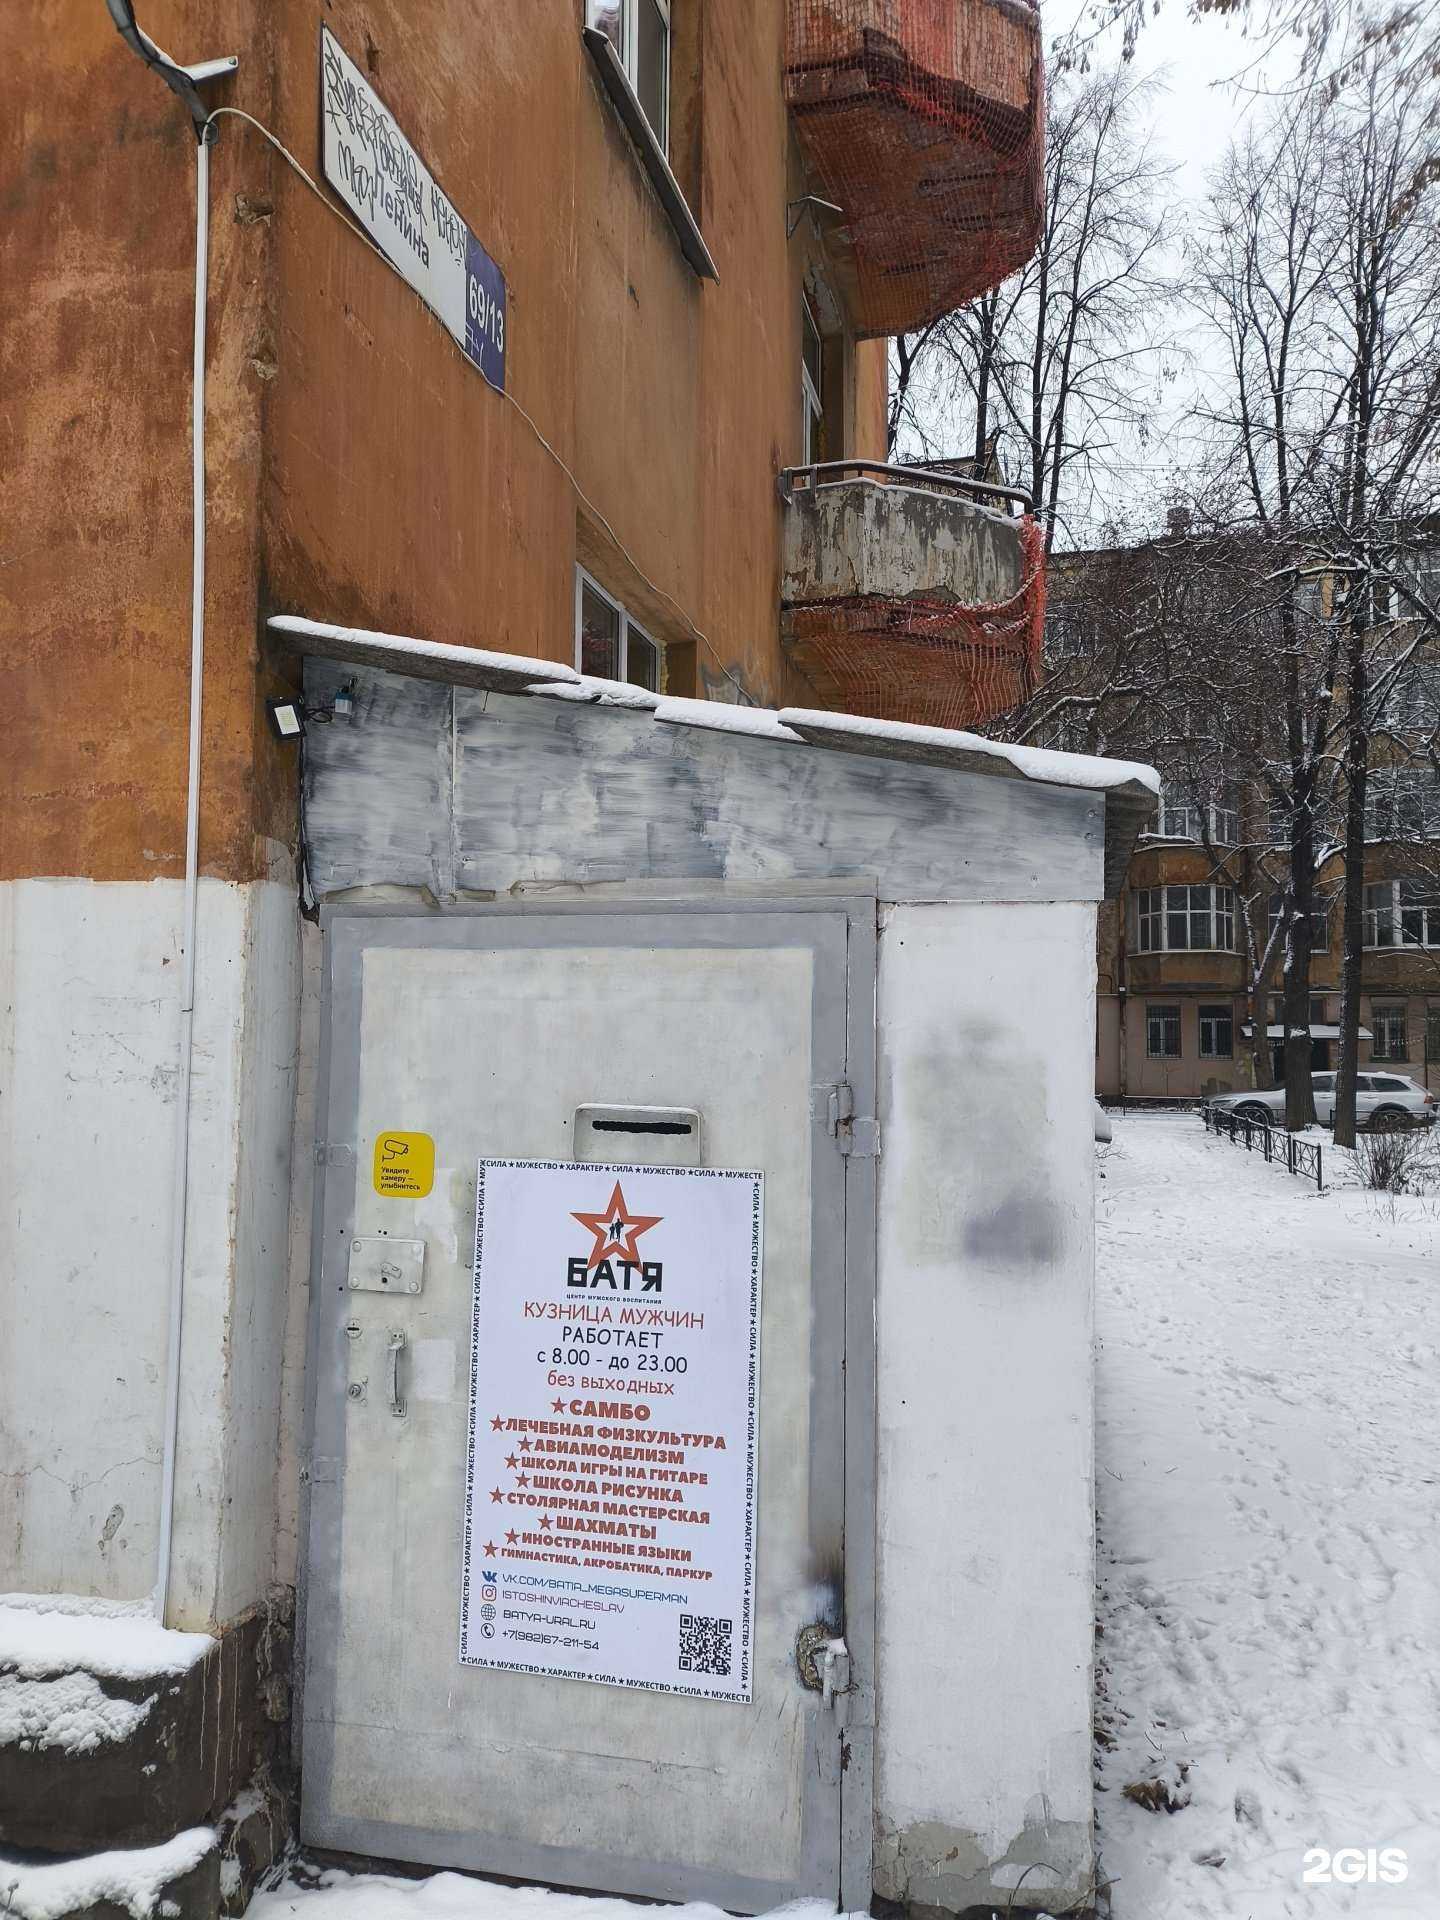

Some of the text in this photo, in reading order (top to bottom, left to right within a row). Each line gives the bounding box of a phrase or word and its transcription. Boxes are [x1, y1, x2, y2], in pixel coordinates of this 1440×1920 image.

[373, 170, 429, 269] Ленина
[469, 274, 504, 353] 69/13
[486, 1160, 507, 1168] СИЛА
[515, 1162, 558, 1170] МУЖЕСТВО
[565, 1163, 603, 1172] ХАРАКТЕР
[611, 1165, 633, 1173] СИЛА
[642, 1167, 686, 1176] МУЖЕСТВО
[694, 1169, 716, 1177] СИЛА
[381, 1182, 421, 1190] улыбнитесь
[567, 1257, 663, 1292] БАТЯ
[524, 1301, 704, 1329] КУЗНИЦА МУЖЧИН
[562, 1326, 663, 1349] РАБОТАЕТ
[552, 1348, 590, 1366] 8.00
[608, 1355, 629, 1370] до
[637, 1354, 688, 1374] 23.00
[547, 1370, 675, 1396] без выходных
[569, 1399, 651, 1421] САМБО
[506, 1418, 727, 1450] ЛЕЧЕБНАЯ ФИЗКУЛЬТУРА
[534, 1438, 685, 1465] АВИАМОДЕЛИЗМ
[521, 1456, 708, 1485] ШКОЛА ИГРЫ НА ГИТАРЕ
[746, 1451, 754, 1500] МУЖЕСТВО
[533, 1475, 684, 1503] ШКОЛА РИСУНКА
[507, 1492, 710, 1524] СТОЛЯРНАЯ МАСТЕРСКАЯ
[462, 1575, 470, 1622] МУЖЕСТВО
[468, 1438, 476, 1483] МУЖЕСТВО
[556, 1515, 657, 1540] ШАХМАТЫ
[521, 1532, 692, 1562] ИНОСТРАННЫЕ ЯЗЫКИ
[501, 1548, 713, 1581] ГИМНАСТИКА, АКРОБАТИКА, ПАРКУР
[503, 1609, 596, 1630] BATYA-URAL.RU
[502, 1630, 600, 1651] +7(982)67-211-54
[467, 1656, 488, 1666] СИЛА
[497, 1661, 539, 1673] МУЖЕСТВО
[547, 1668, 586, 1680] ХАРАКТЕР
[594, 1674, 616, 1683] СИЛА
[626, 1679, 671, 1691] МУЖЕСТВО
[679, 1686, 701, 1696] СИЛА
